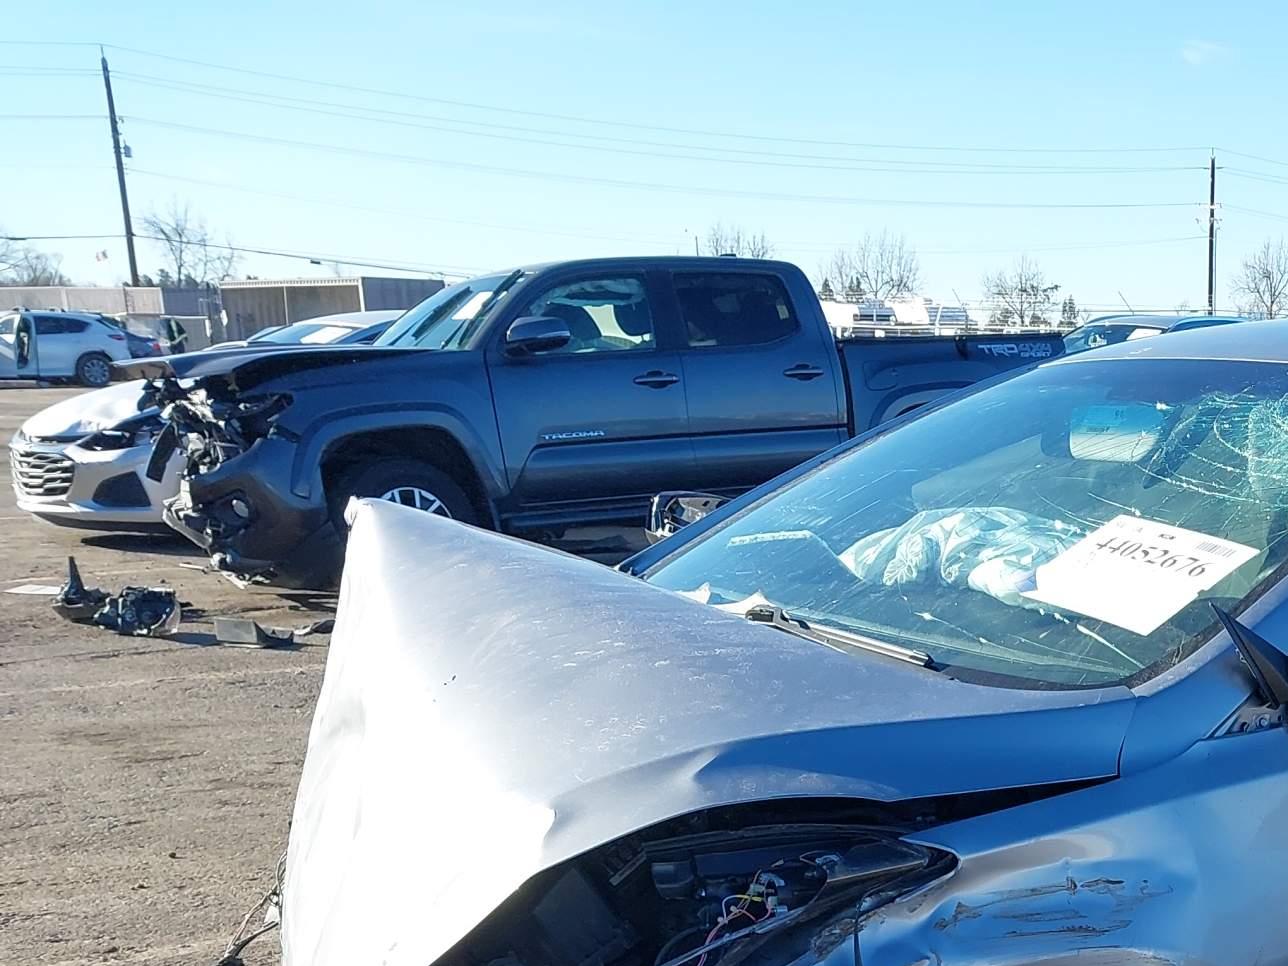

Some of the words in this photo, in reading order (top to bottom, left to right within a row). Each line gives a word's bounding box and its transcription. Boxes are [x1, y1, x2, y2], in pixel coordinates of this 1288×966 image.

[977, 343, 1019, 356] TRD
[541, 430, 605, 440] TACOMA
[1095, 537, 1215, 577] 44052676
